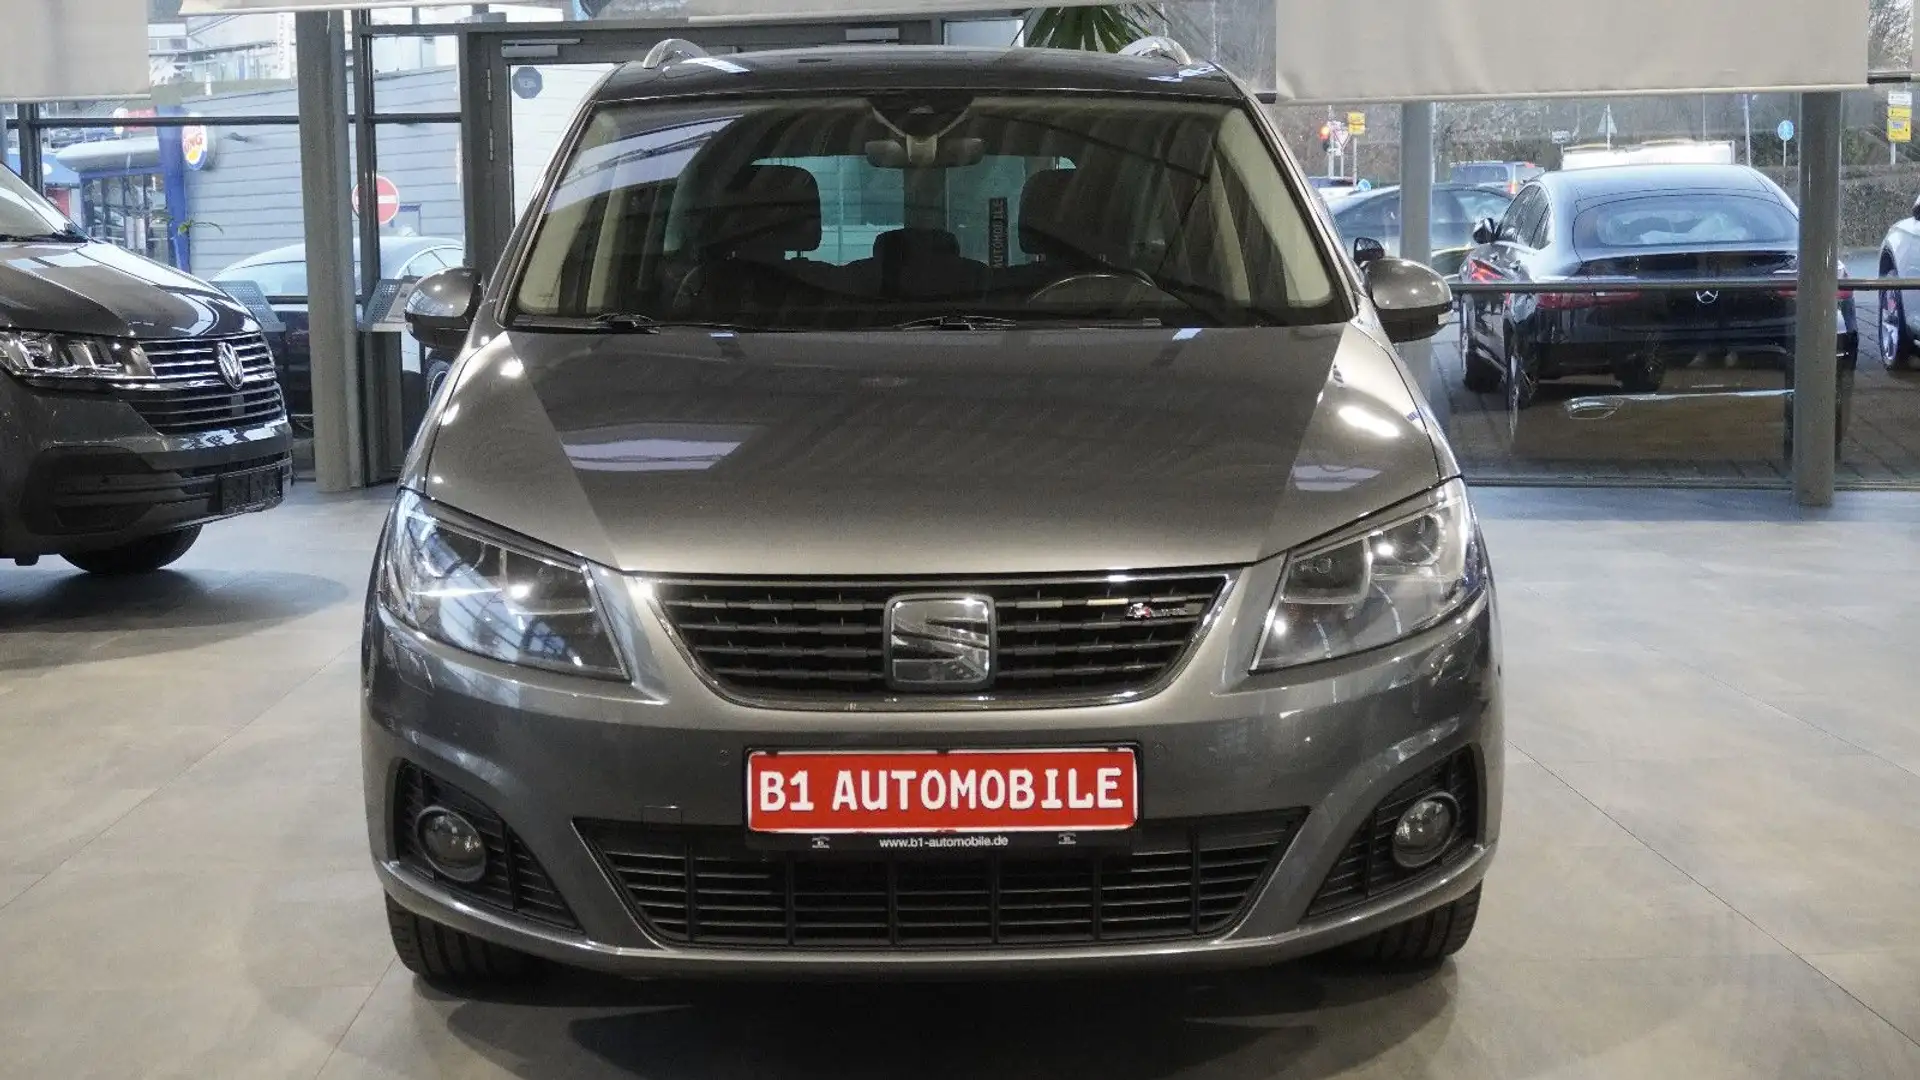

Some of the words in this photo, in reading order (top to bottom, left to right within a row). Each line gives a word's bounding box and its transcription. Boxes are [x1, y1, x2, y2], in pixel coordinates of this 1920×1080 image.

[760, 770, 814, 811] B1
[832, 768, 1124, 811] AUTOMOBILE
[878, 836, 1009, 848] www.b1-automobile.de
